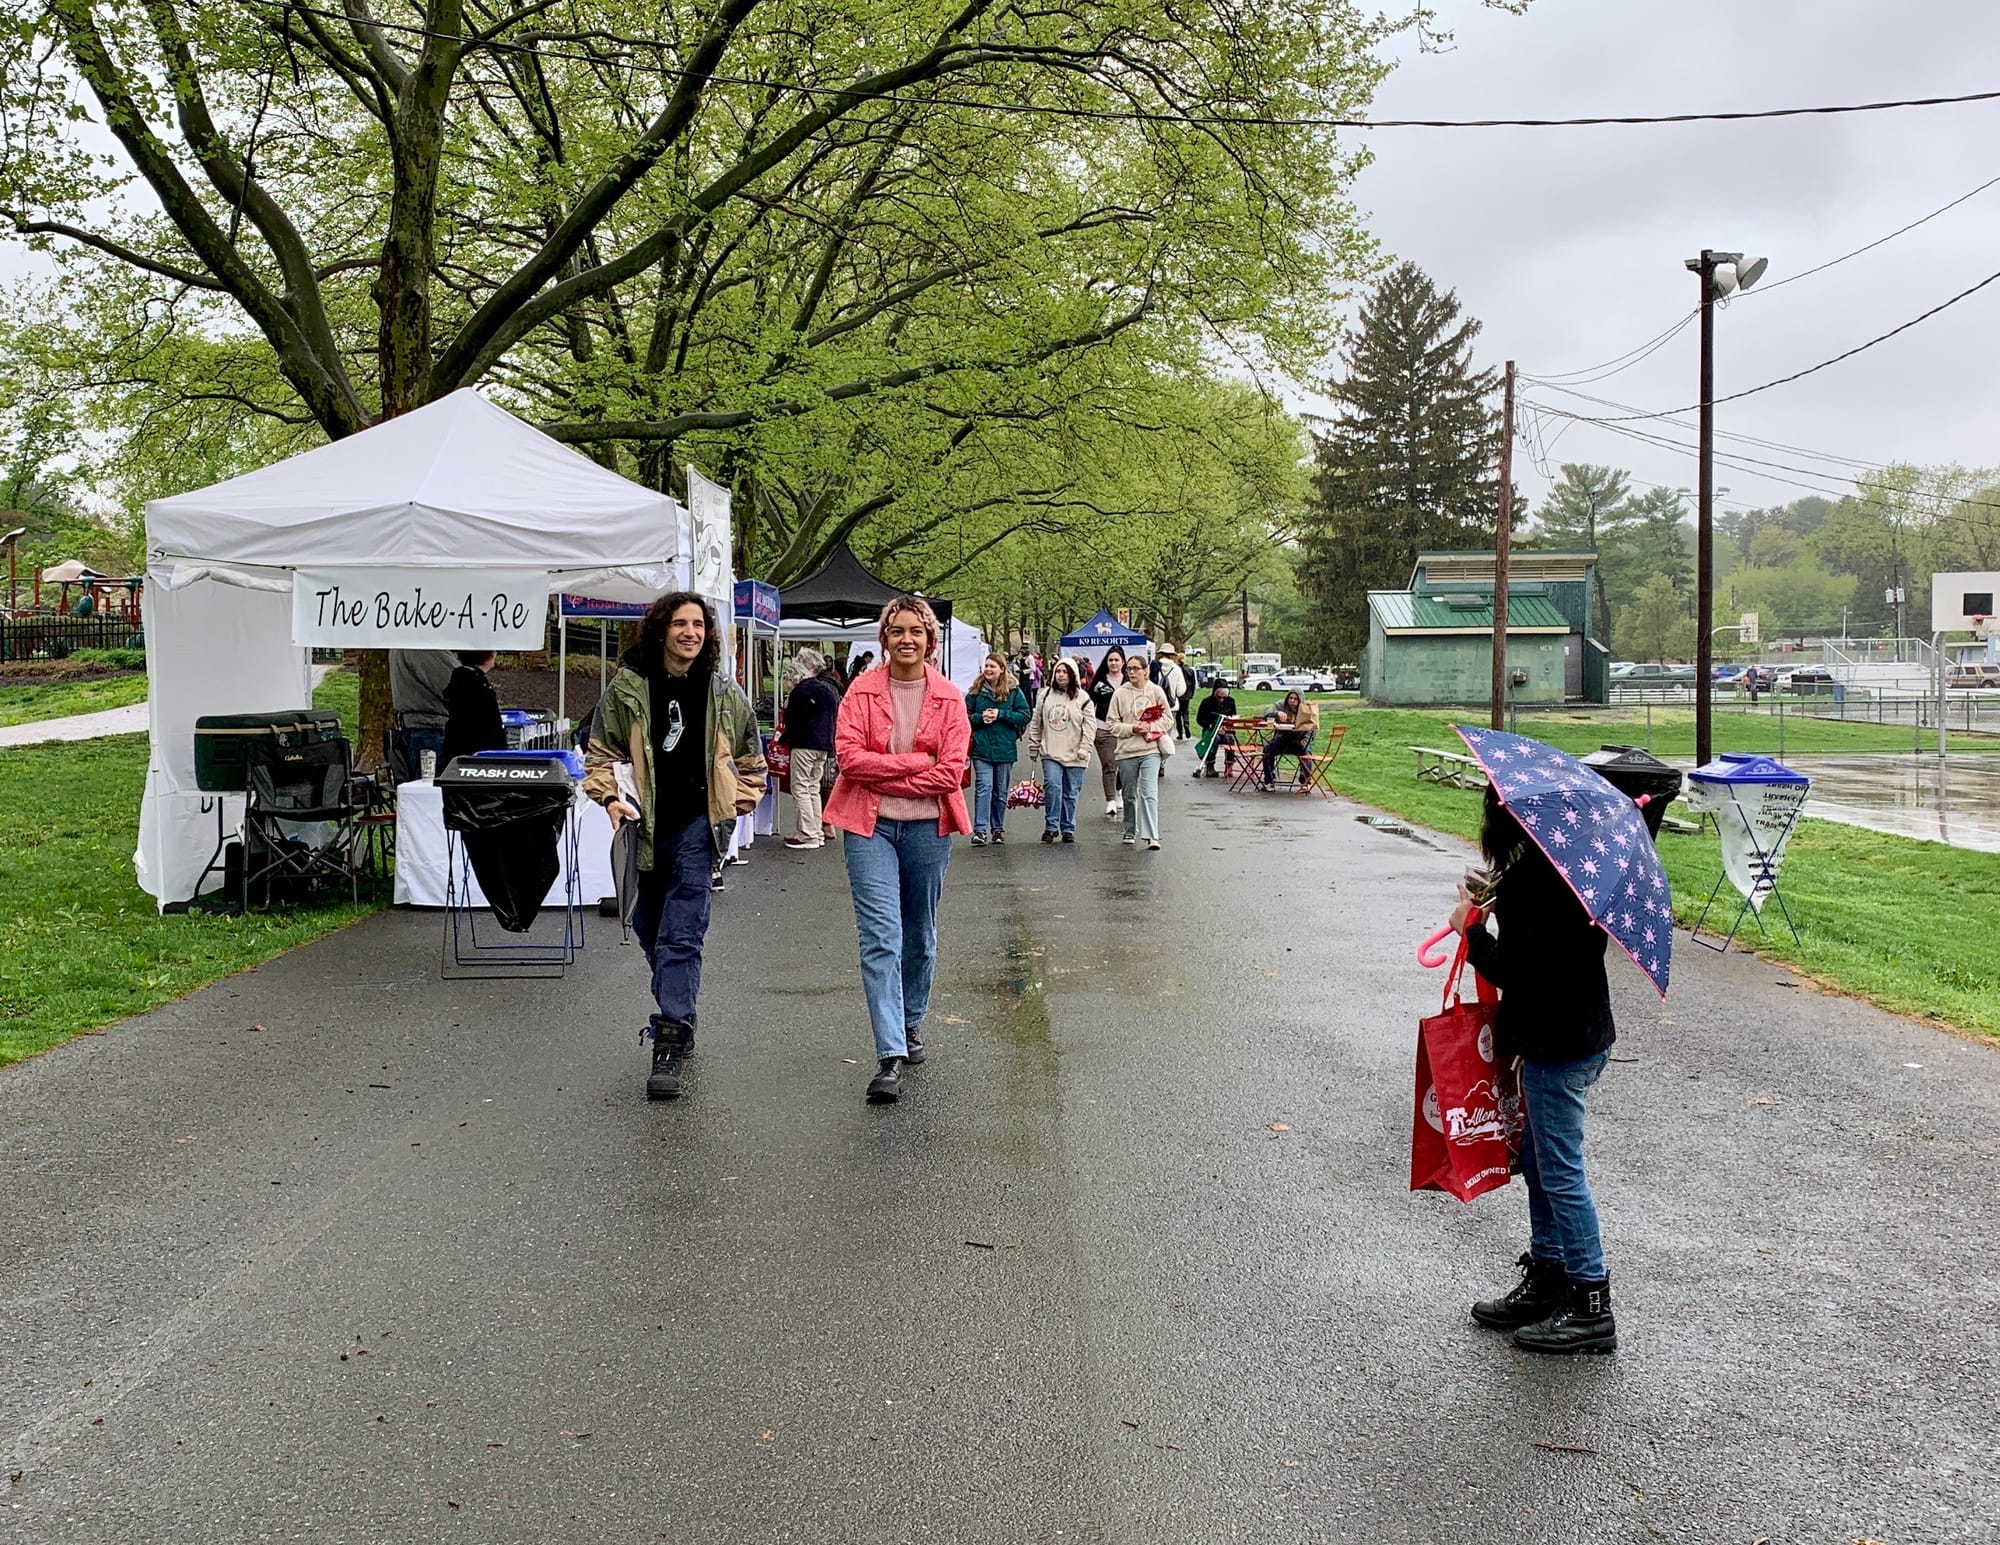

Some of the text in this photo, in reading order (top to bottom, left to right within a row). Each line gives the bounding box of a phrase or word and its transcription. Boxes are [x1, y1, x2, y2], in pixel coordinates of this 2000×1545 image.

[315, 586, 368, 627] The
[1079, 637, 1129, 646] K9 RESORTS
[458, 768, 549, 779] TRASH ONLY
[1481, 1167, 1507, 1178] OWNED
